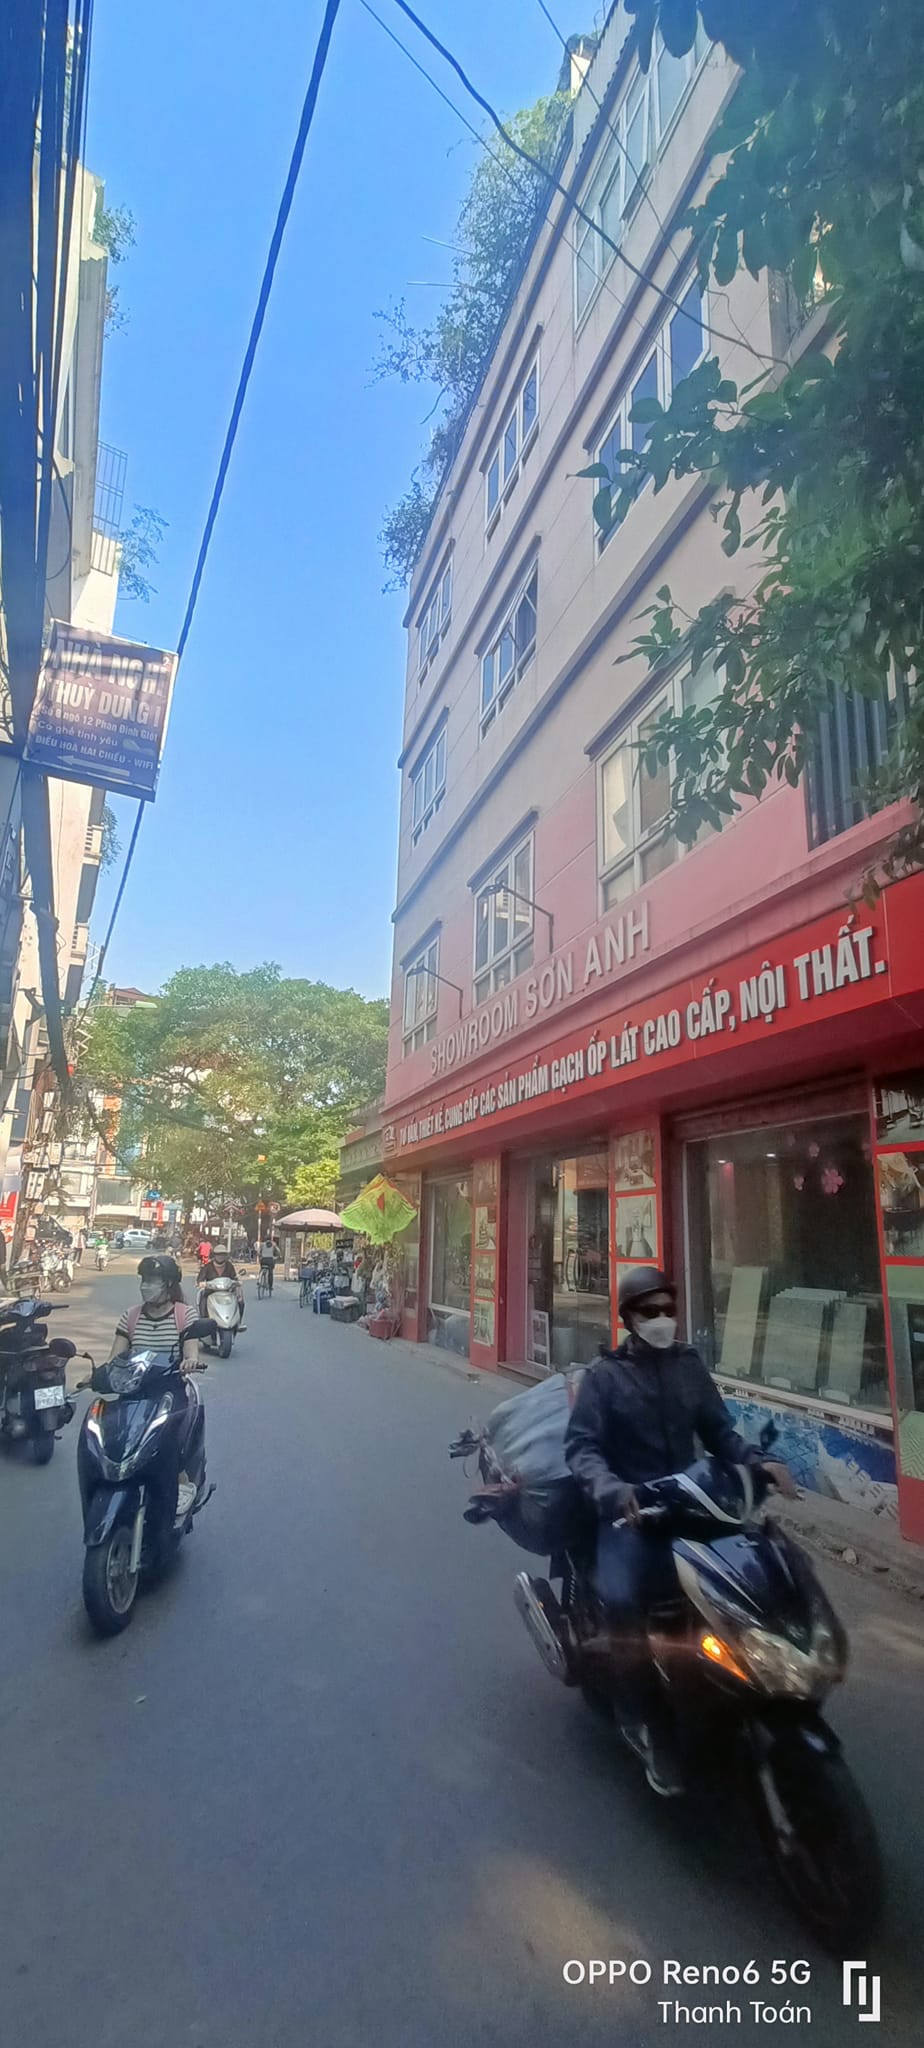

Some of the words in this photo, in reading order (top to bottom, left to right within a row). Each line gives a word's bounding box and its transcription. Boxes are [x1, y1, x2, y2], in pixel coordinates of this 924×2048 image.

[53, 638, 102, 680] NHÀ
[82, 715, 94, 726] 12
[95, 718, 118, 733] Phan
[98, 691, 150, 725] DUNG
[431, 989, 518, 1077] SHOWROOM
[525, 950, 574, 1019] SƠN
[583, 900, 650, 985] ANH
[463, 1087, 479, 1122] CẤP
[480, 1082, 496, 1117] CÁC
[551, 1049, 584, 1094] GẠCH
[587, 1029, 607, 1076] ỐP
[610, 1021, 639, 1069] LÁT
[643, 1009, 681, 1056] CAO
[686, 976, 736, 1041] CẤP,
[739, 960, 786, 1023] NỘI
[793, 914, 887, 1000] THẤT.
